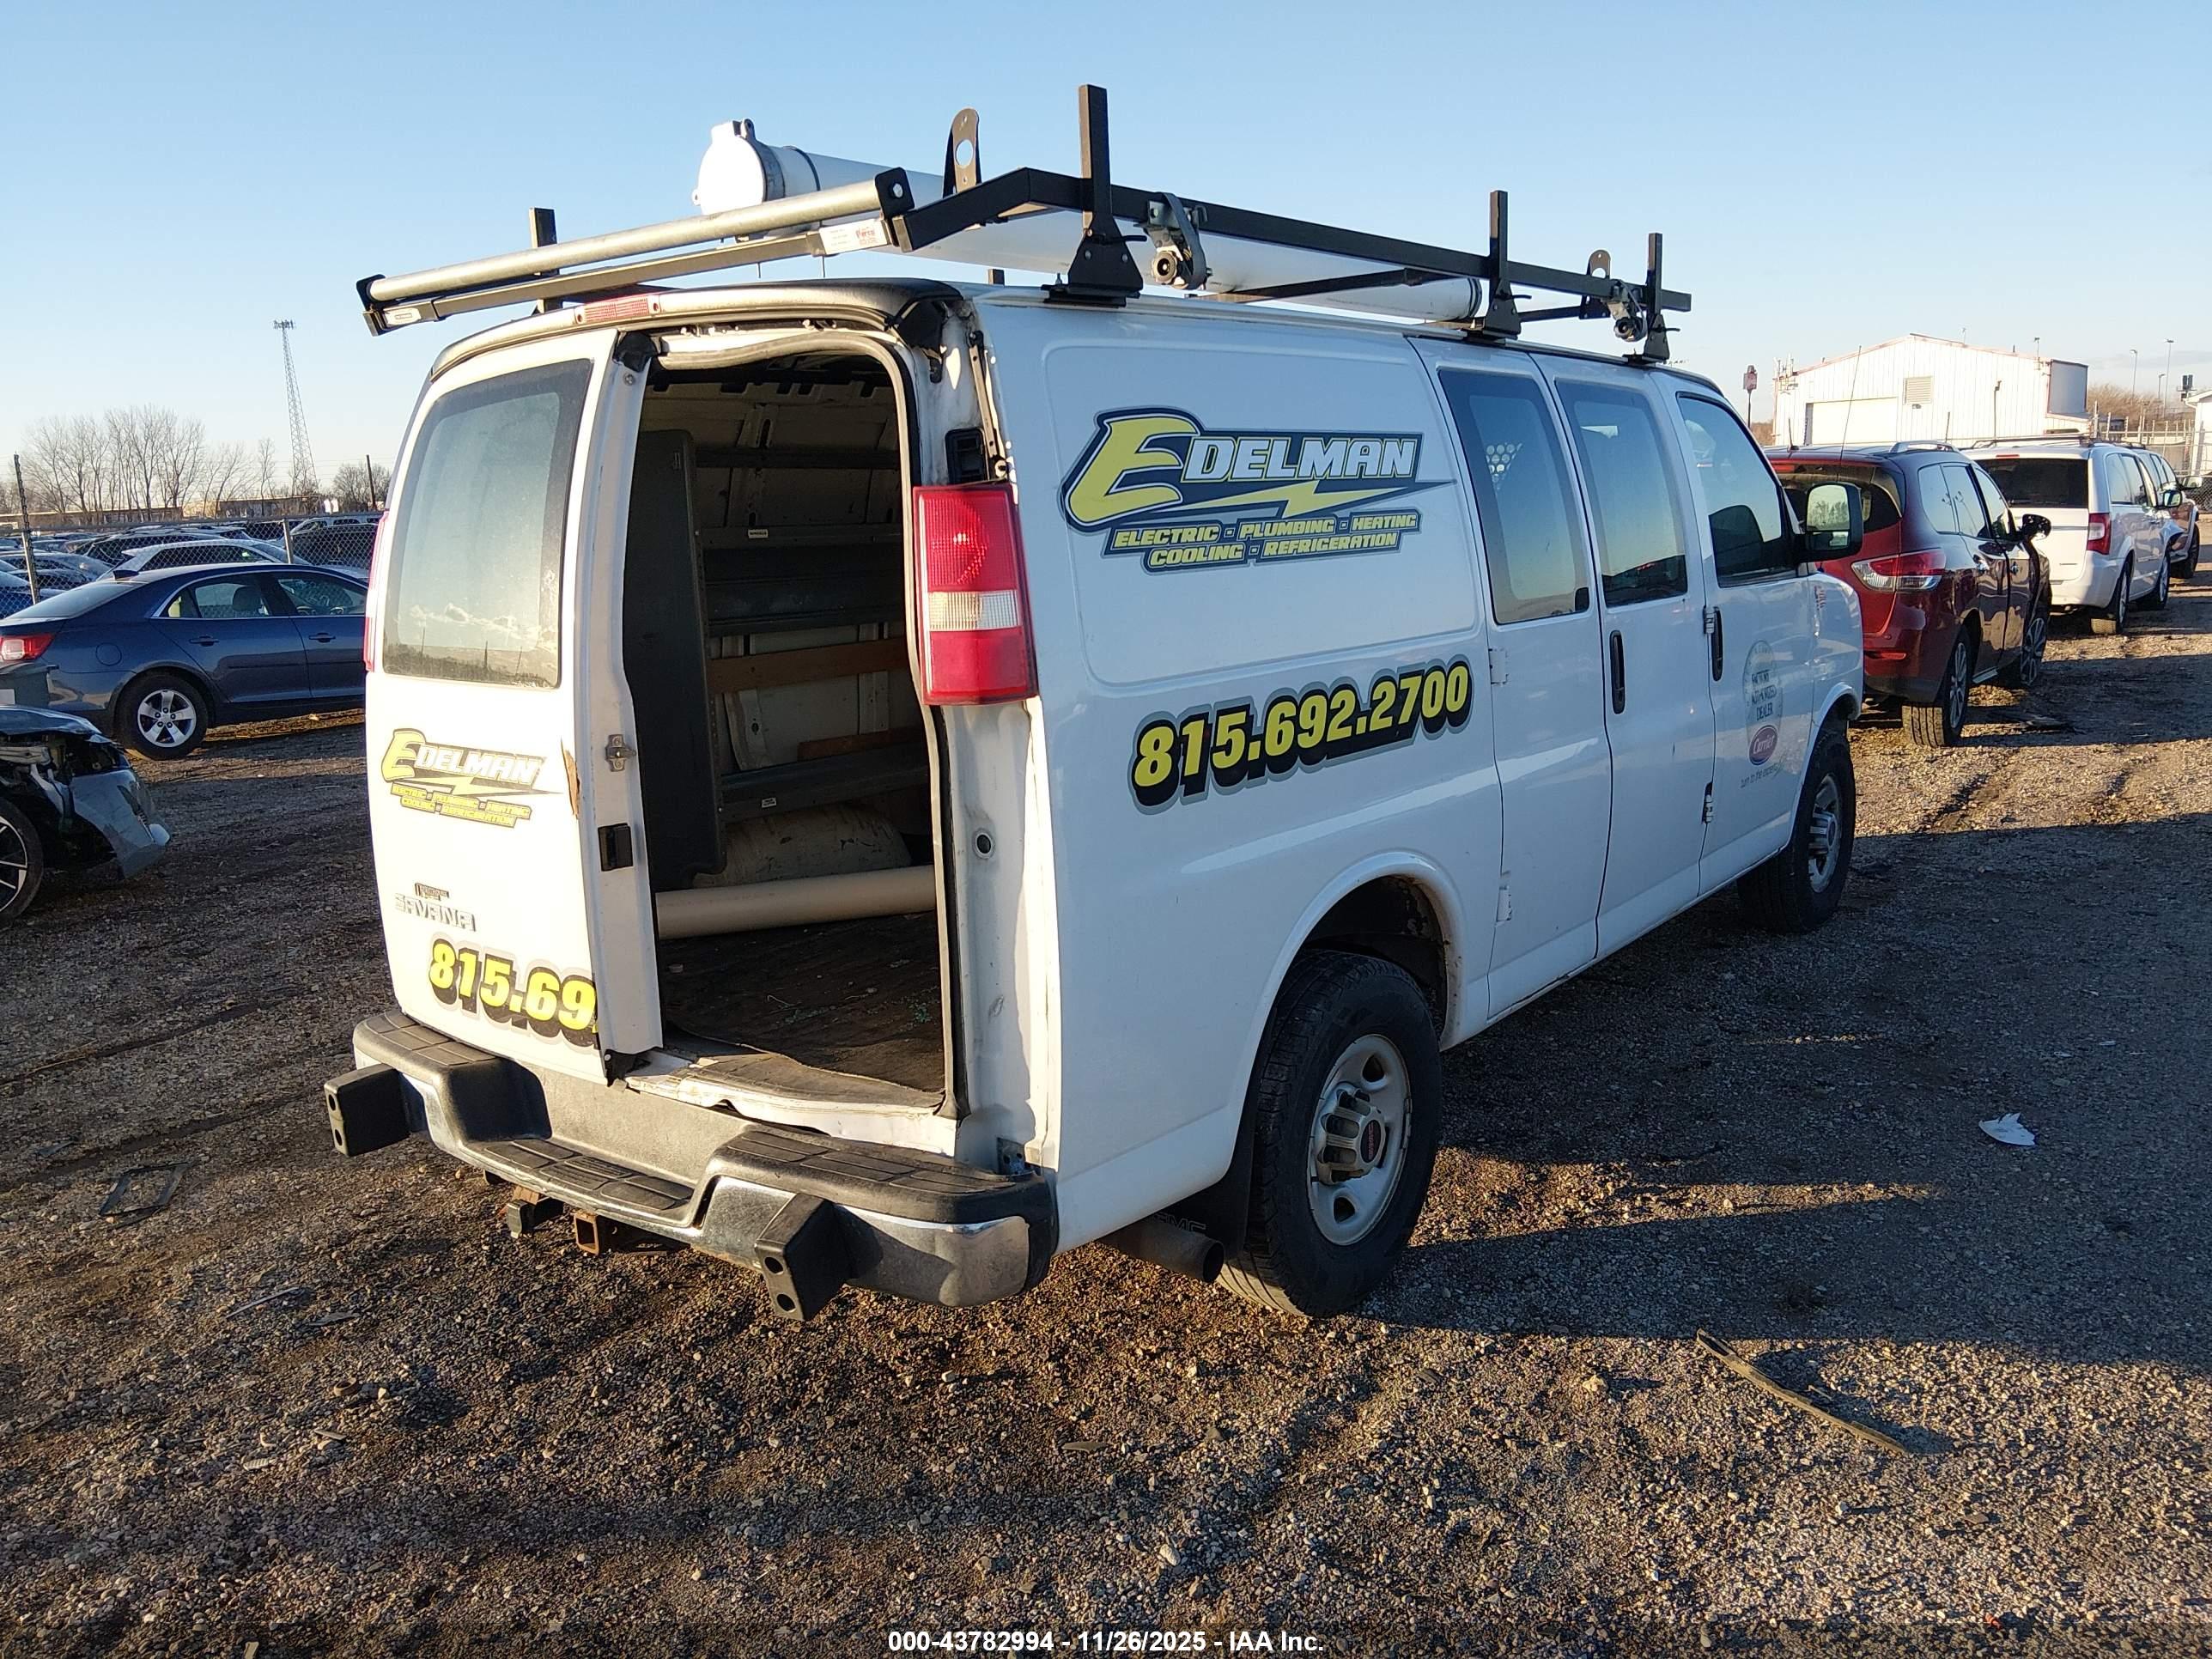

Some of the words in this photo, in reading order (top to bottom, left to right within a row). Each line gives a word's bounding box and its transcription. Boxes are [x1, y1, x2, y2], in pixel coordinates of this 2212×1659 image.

[1068, 413, 1416, 526] EDELMAN
[1115, 526, 1220, 550] ELECTRIC
[1239, 518, 1335, 540] PLUMBING
[1352, 513, 1417, 532] HEATING
[1149, 544, 1243, 568] COOLING
[1263, 532, 1397, 557] REFRIGERATION
[1132, 664, 1471, 795] 815.692.2700
[1756, 702, 1773, 721] DEALER
[382, 729, 543, 782] EDELMAN
[1753, 734, 1775, 755] Carrier
[394, 893, 477, 932] SAVANA
[429, 939, 599, 1037] 815.69
